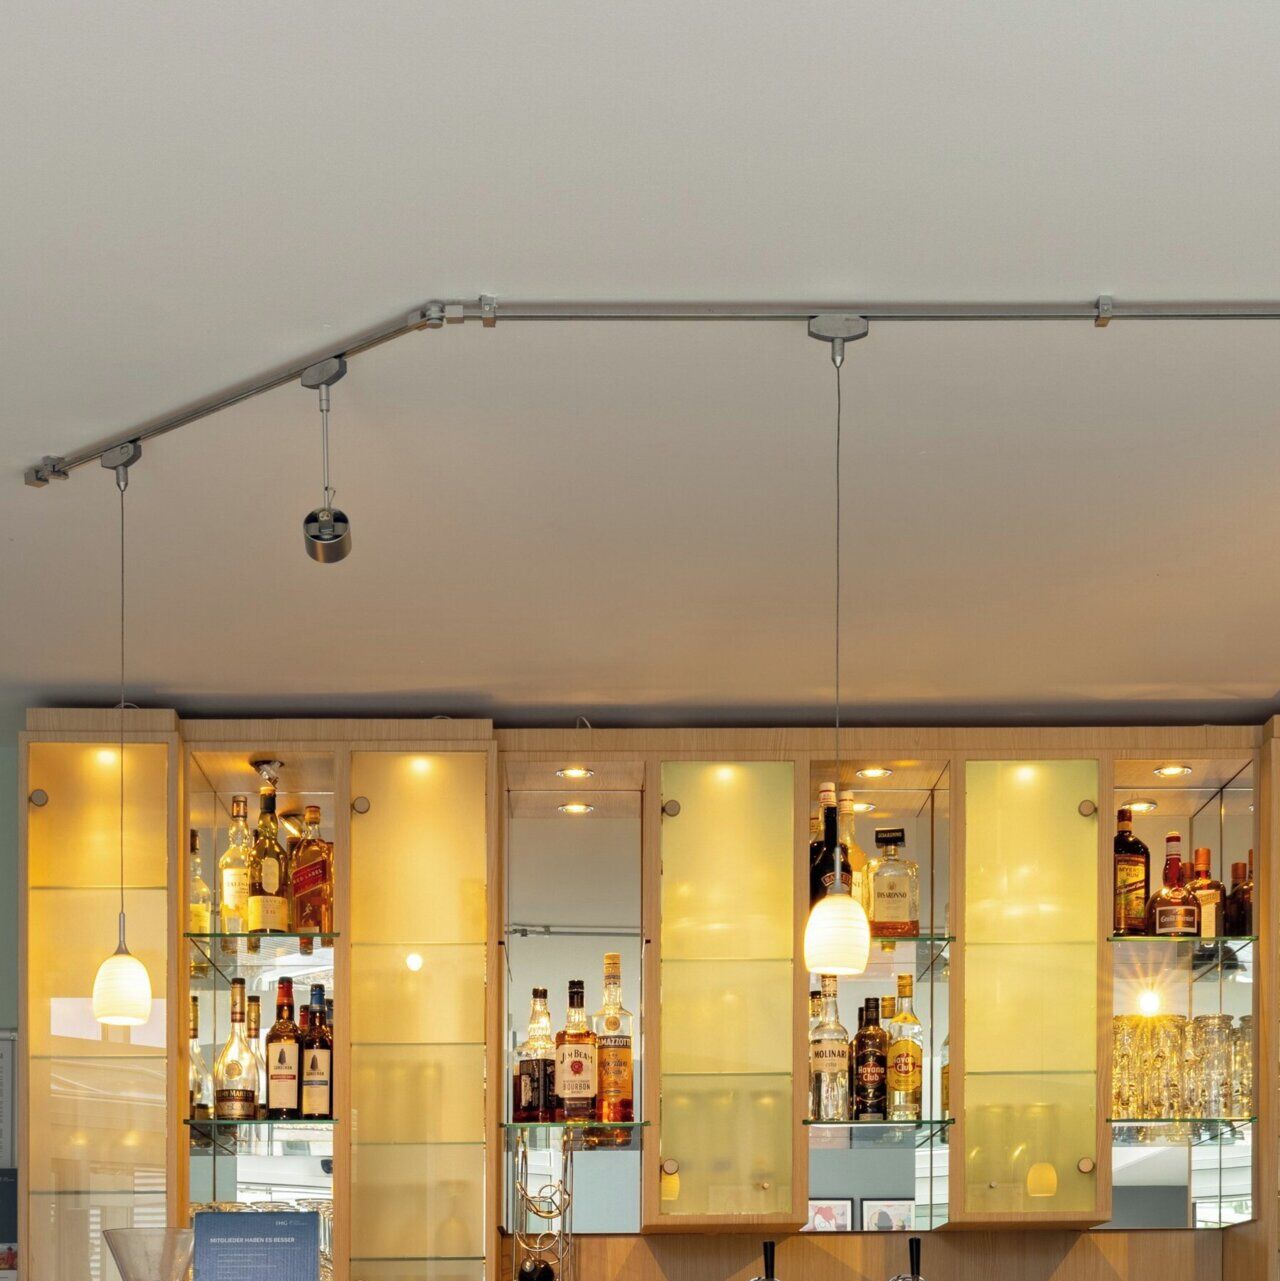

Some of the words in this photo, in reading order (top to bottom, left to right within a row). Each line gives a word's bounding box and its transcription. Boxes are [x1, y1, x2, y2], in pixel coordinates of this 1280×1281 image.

[876, 891, 907, 899] DISARONNO
[574, 1049, 593, 1065] BEAM
[858, 1065, 885, 1074] Havana
[863, 1073, 880, 1081] Club
[867, 1088, 875, 1098] 7
